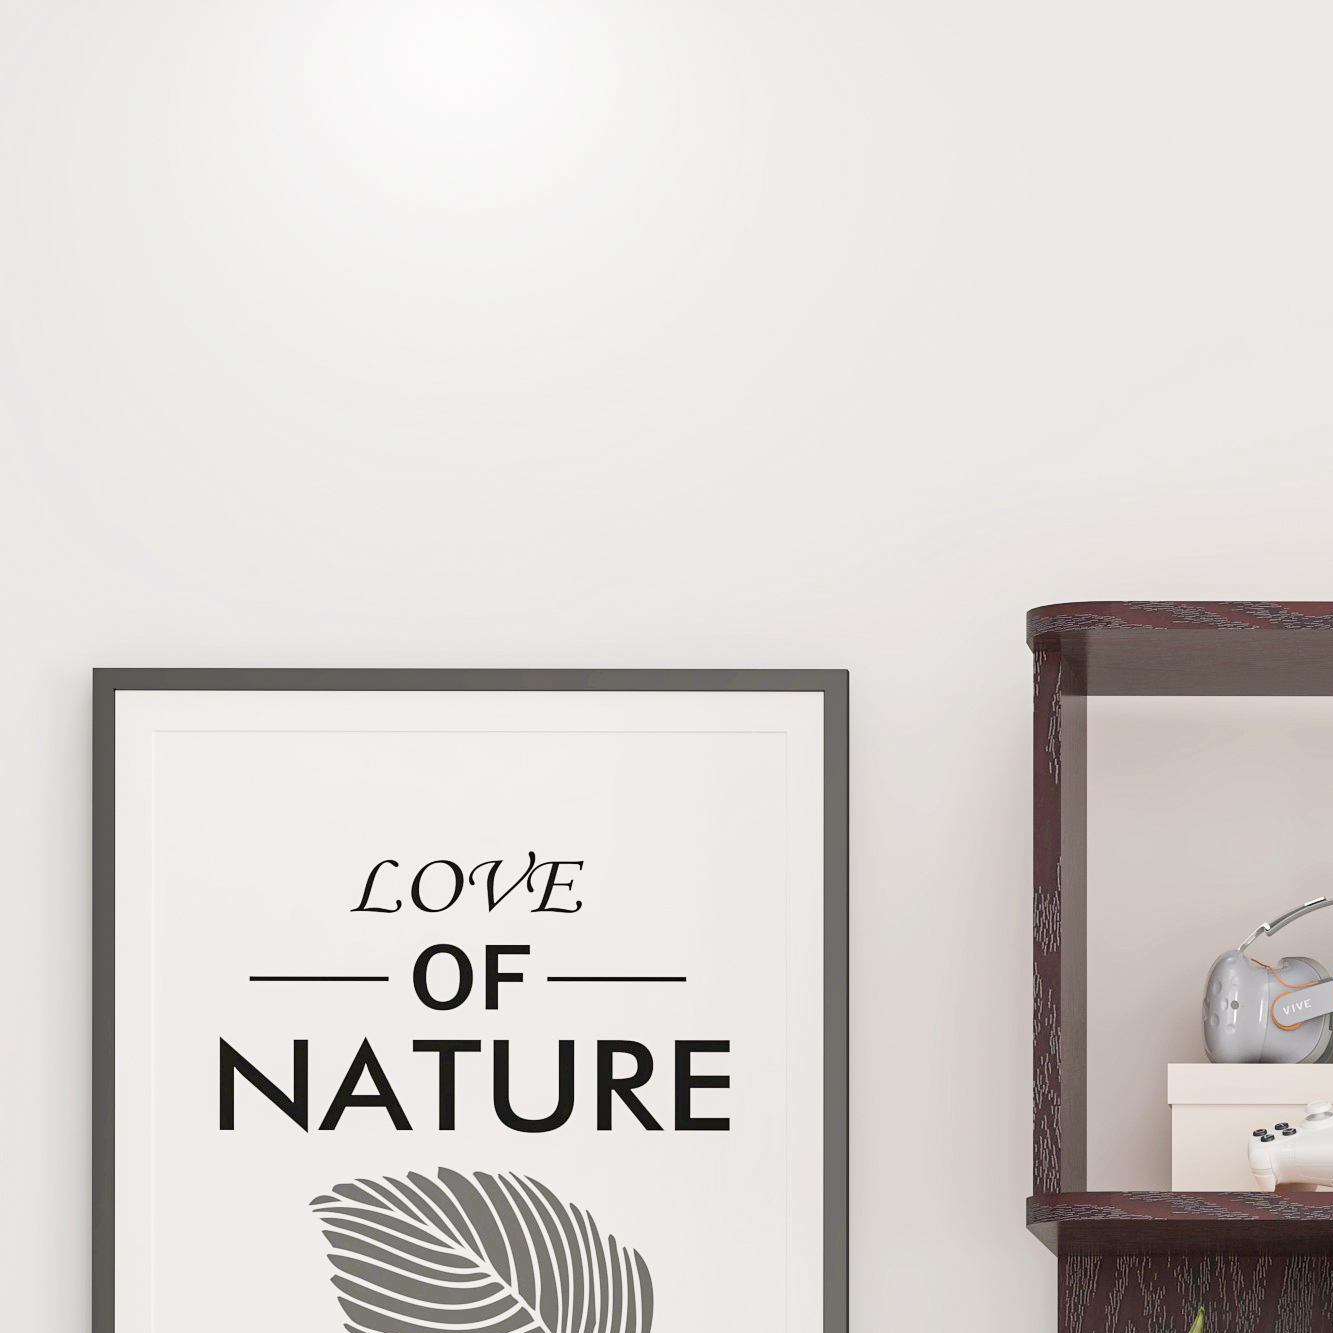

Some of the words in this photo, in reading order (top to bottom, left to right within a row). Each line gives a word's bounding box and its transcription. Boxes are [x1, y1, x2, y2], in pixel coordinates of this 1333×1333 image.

[350, 850, 585, 914] LOVE
[412, 943, 531, 1011] OF
[1282, 998, 1313, 1016] VIVE
[219, 1036, 731, 1134] NATURE
